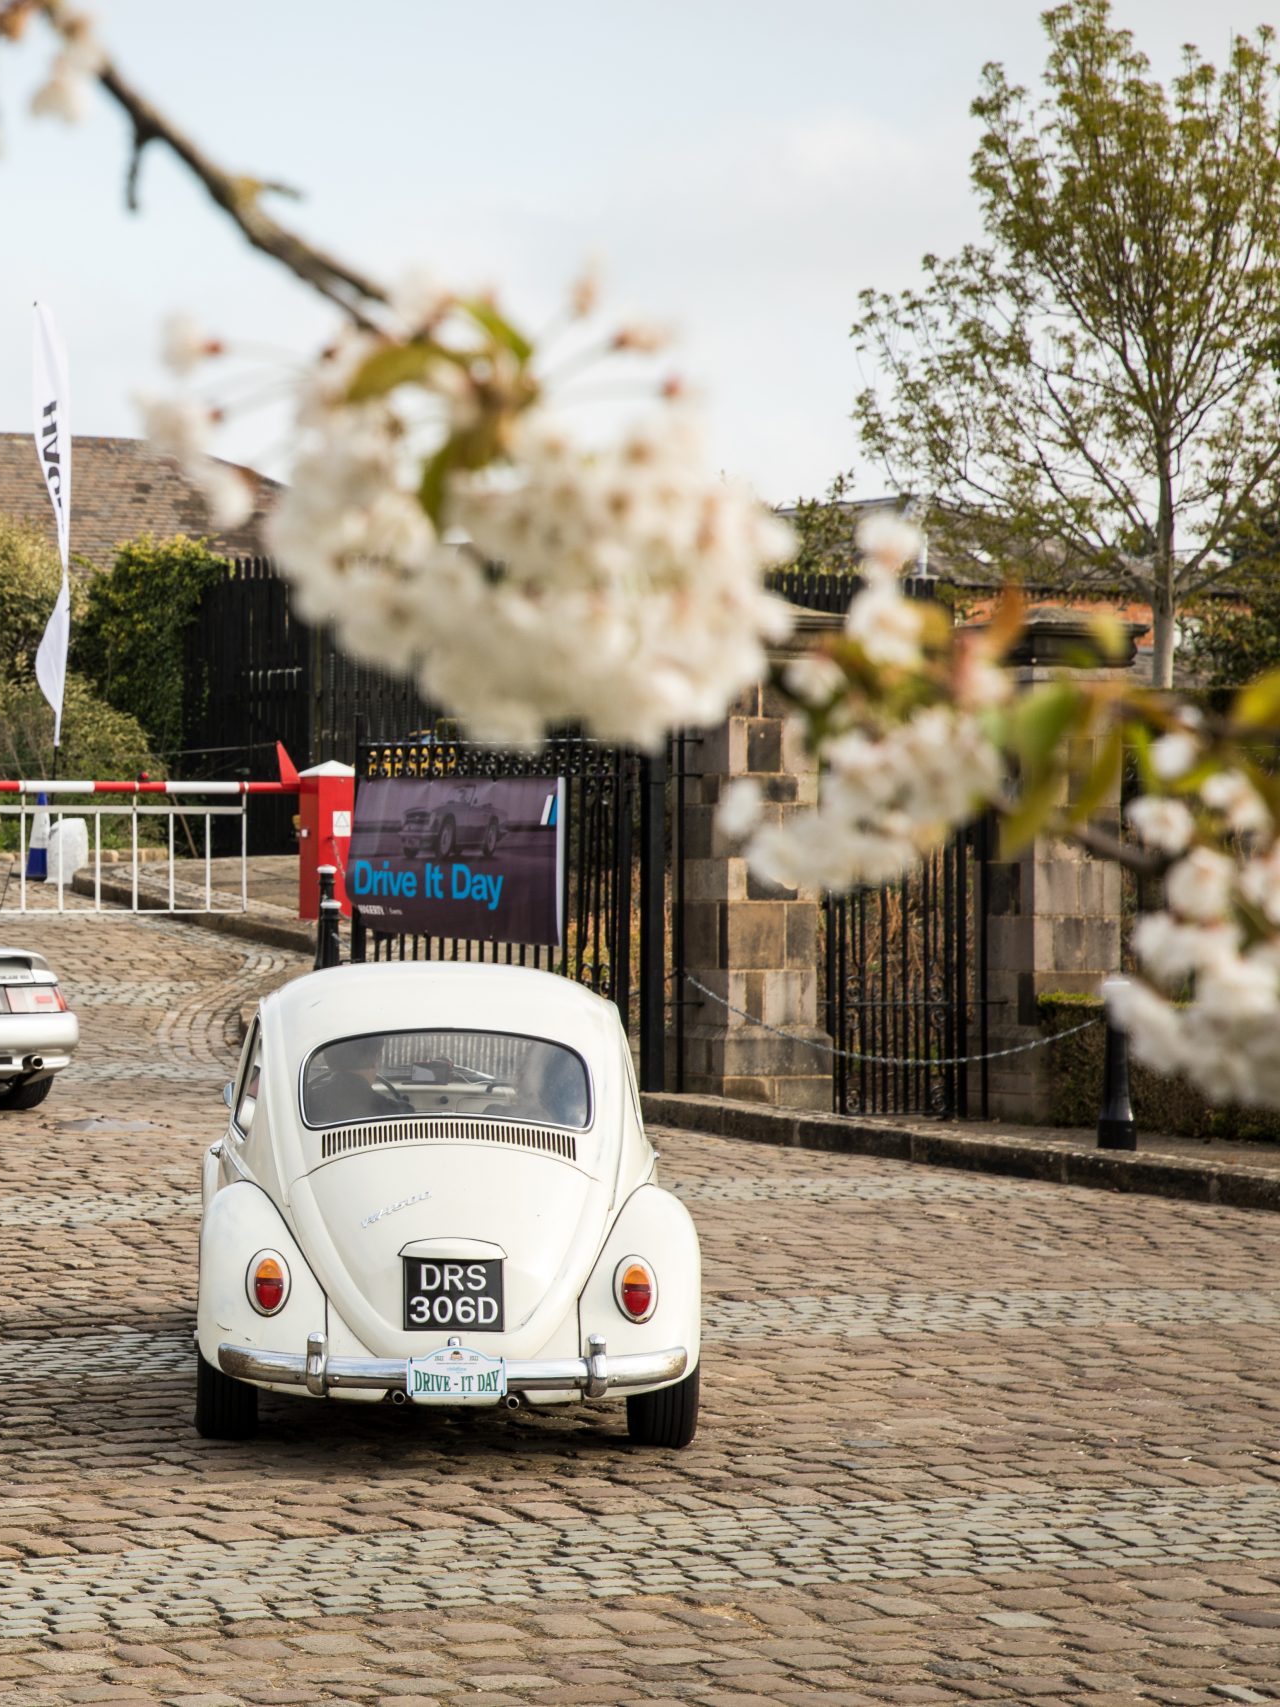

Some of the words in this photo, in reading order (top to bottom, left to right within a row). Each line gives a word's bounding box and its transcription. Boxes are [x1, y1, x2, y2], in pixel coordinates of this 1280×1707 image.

[354, 860, 417, 897] Drive
[425, 863, 444, 899] It
[452, 863, 504, 910] Day
[420, 1264, 487, 1291] DRS
[409, 1296, 498, 1324] 306D
[413, 1369, 451, 1392] DRIVE
[461, 1375, 474, 1392] IT
[477, 1369, 500, 1392] DAY
